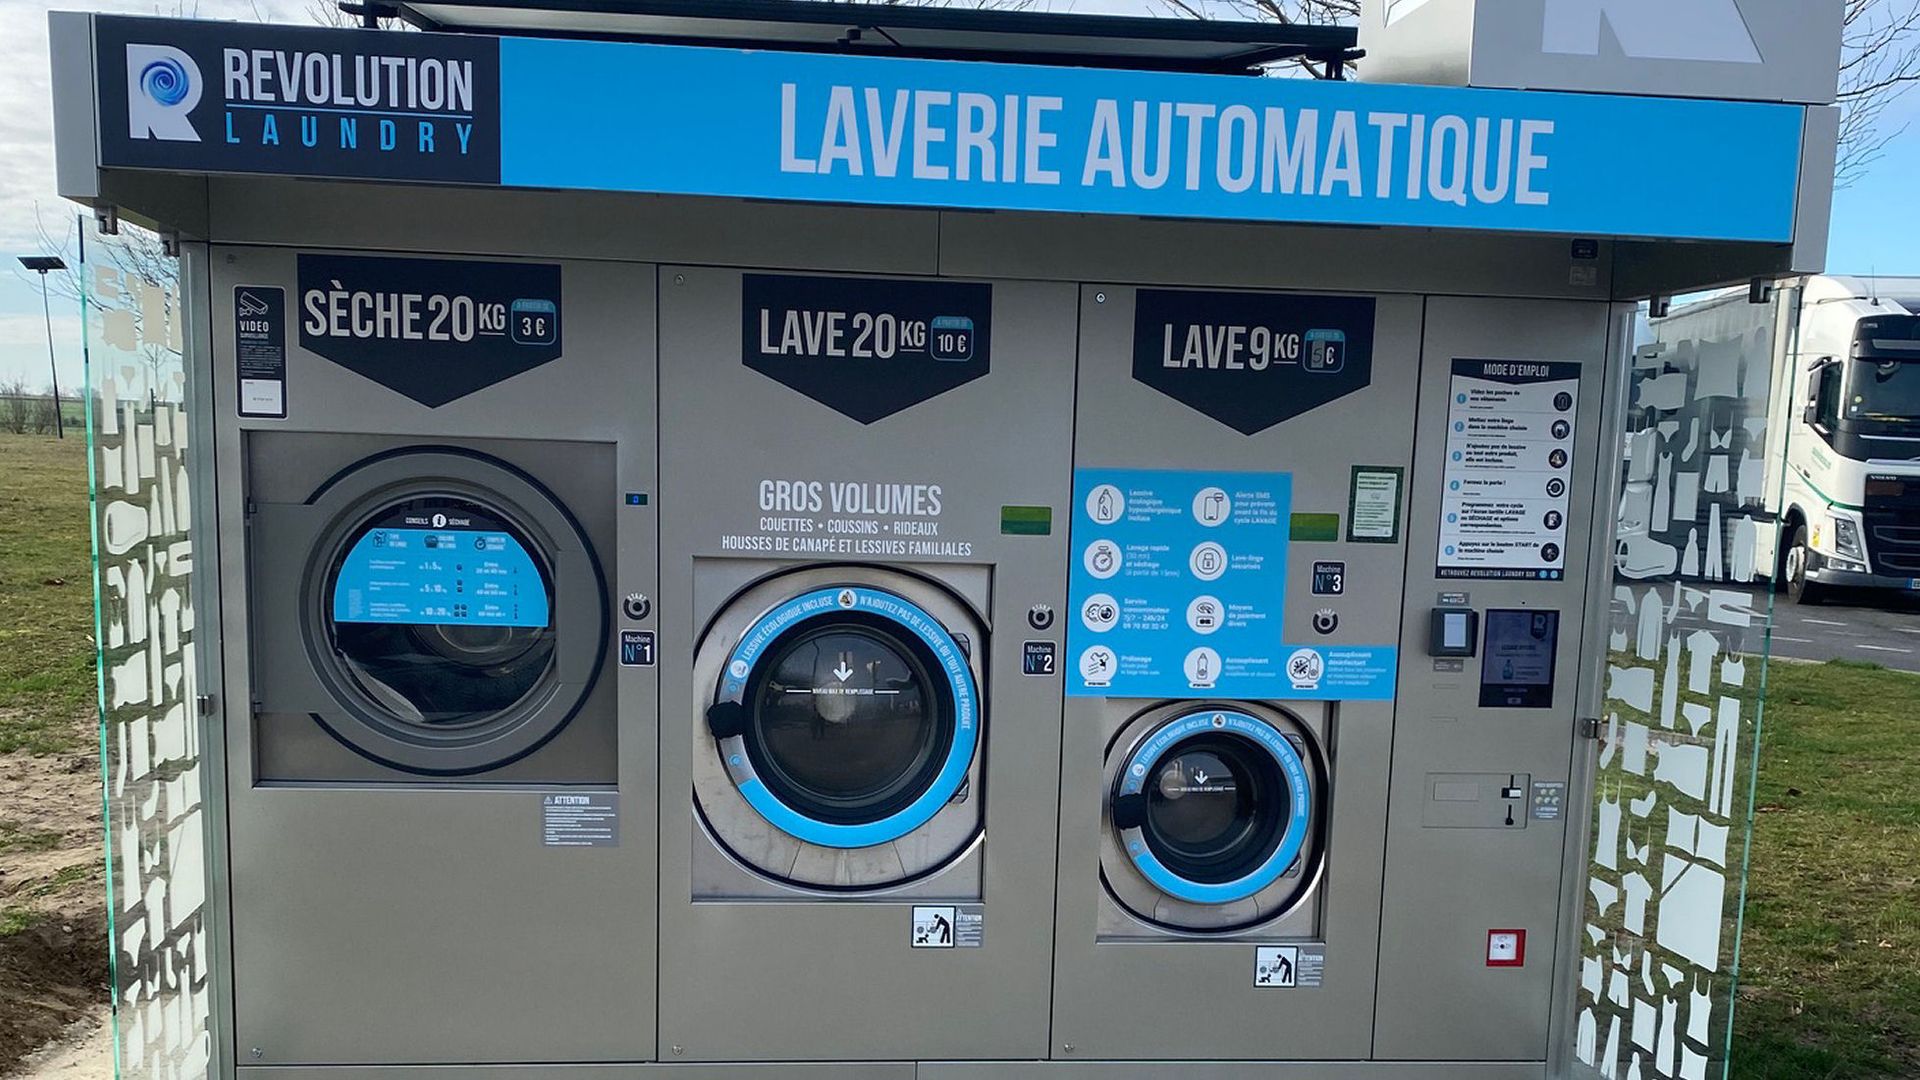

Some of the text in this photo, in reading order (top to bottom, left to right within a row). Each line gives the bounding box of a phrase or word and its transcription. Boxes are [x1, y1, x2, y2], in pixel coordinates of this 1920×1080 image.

[223, 48, 473, 111] REVOLUTION
[225, 111, 473, 154] LAUNDRY
[781, 83, 1555, 207] LAVERIE AUTOMATIQUE
[304, 279, 505, 342] SÈCHE 20 KG
[239, 320, 270, 332] VIDEO
[522, 317, 545, 336] 3 €
[760, 308, 926, 359] LAVE 20 KG
[937, 334, 967, 353] 10 €
[1162, 323, 1299, 371] LAVE 9 KG
[1483, 363, 1550, 378] MODE D'EMPLOI
[759, 479, 942, 517] GROS VOLUMES
[1129, 489, 1153, 497] Lessive
[1235, 491, 1255, 499] Alerte
[1129, 498, 1163, 506] écologique
[759, 517, 938, 536] COUETTES COUSSINS RIDEAUX
[1234, 517, 1250, 525] cycle
[722, 535, 972, 557] HOUSSES DE CANAPÉ ET LESSIVES FAMILIALES
[1126, 544, 1149, 552] Lavage
[1231, 554, 1264, 562] Lave-linge
[1316, 564, 1341, 573] Machine
[1228, 604, 1253, 612] Moyens
[741, 595, 833, 660] LESSIVE ÉCOLOGIQUE INCLUSE
[625, 634, 651, 643] Machine
[896, 604, 911, 621] PAS
[909, 613, 921, 627] DE
[919, 622, 945, 649] LESSIVE
[946, 653, 961, 674] TOUT
[954, 673, 968, 698] AUTRE
[1027, 645, 1052, 653] Machine
[554, 796, 590, 805] ATTENTION
